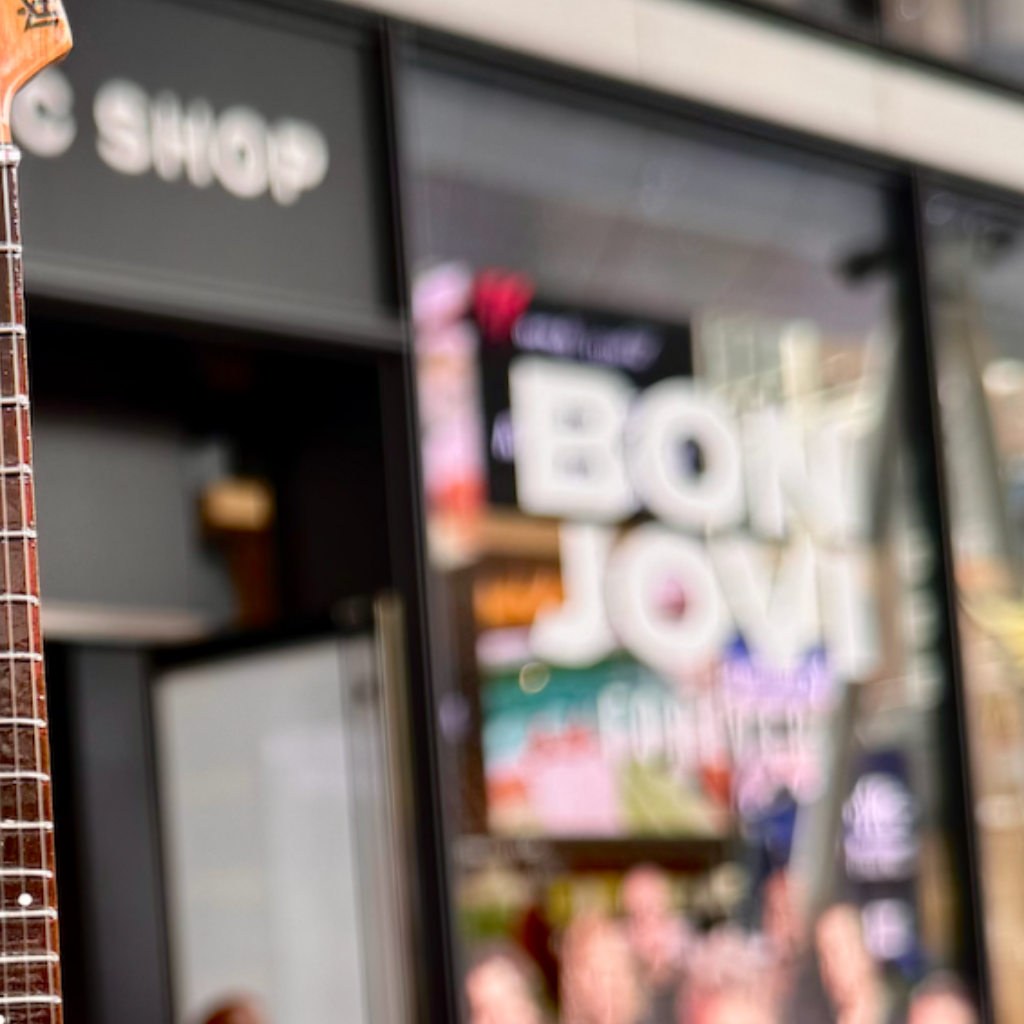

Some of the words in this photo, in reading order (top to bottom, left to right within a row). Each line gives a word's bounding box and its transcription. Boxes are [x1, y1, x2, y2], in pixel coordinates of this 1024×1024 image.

[92, 78, 329, 206] SHOP
[509, 355, 874, 550] BON
[528, 520, 875, 685] JOVI
